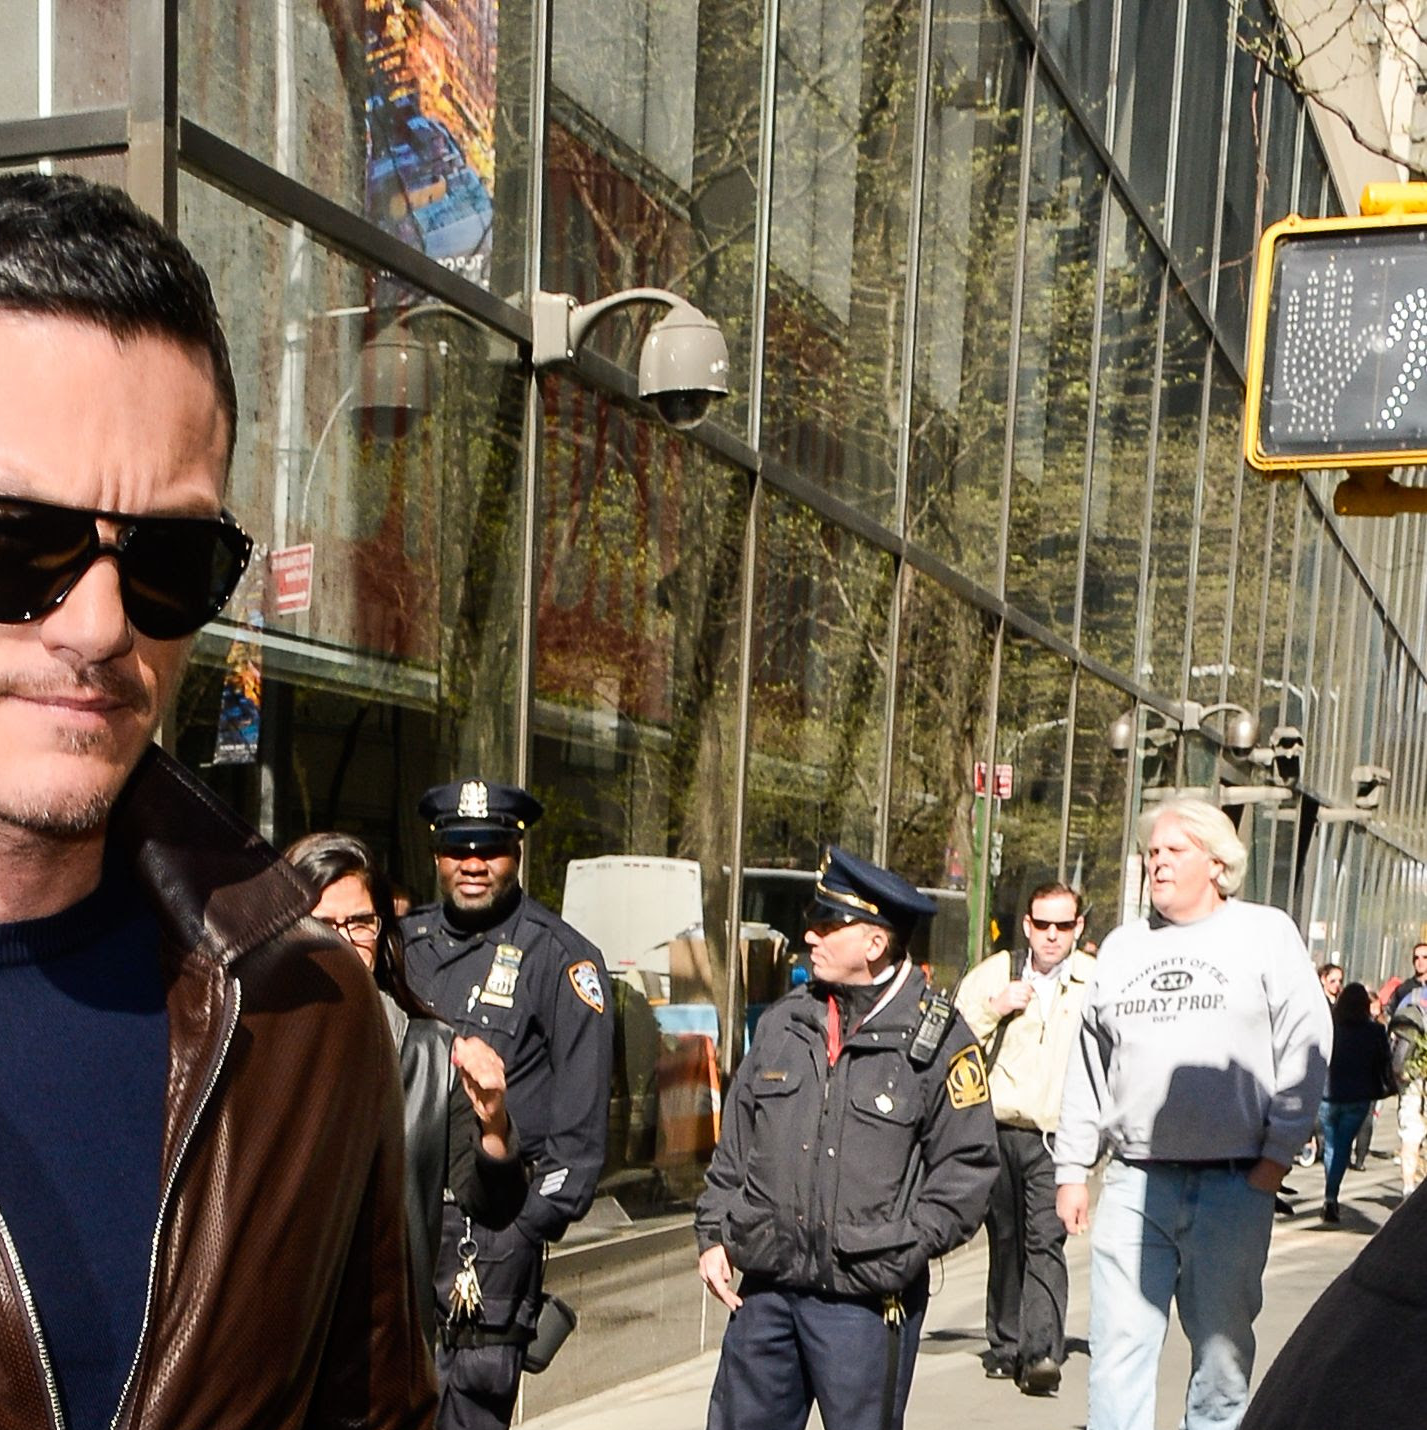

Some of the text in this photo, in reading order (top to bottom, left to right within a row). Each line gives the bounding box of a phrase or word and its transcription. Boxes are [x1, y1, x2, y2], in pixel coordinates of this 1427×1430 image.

[1121, 957, 1229, 993] PROPERTY OF THE
[1115, 994, 1227, 1017] TODAY PROP.
